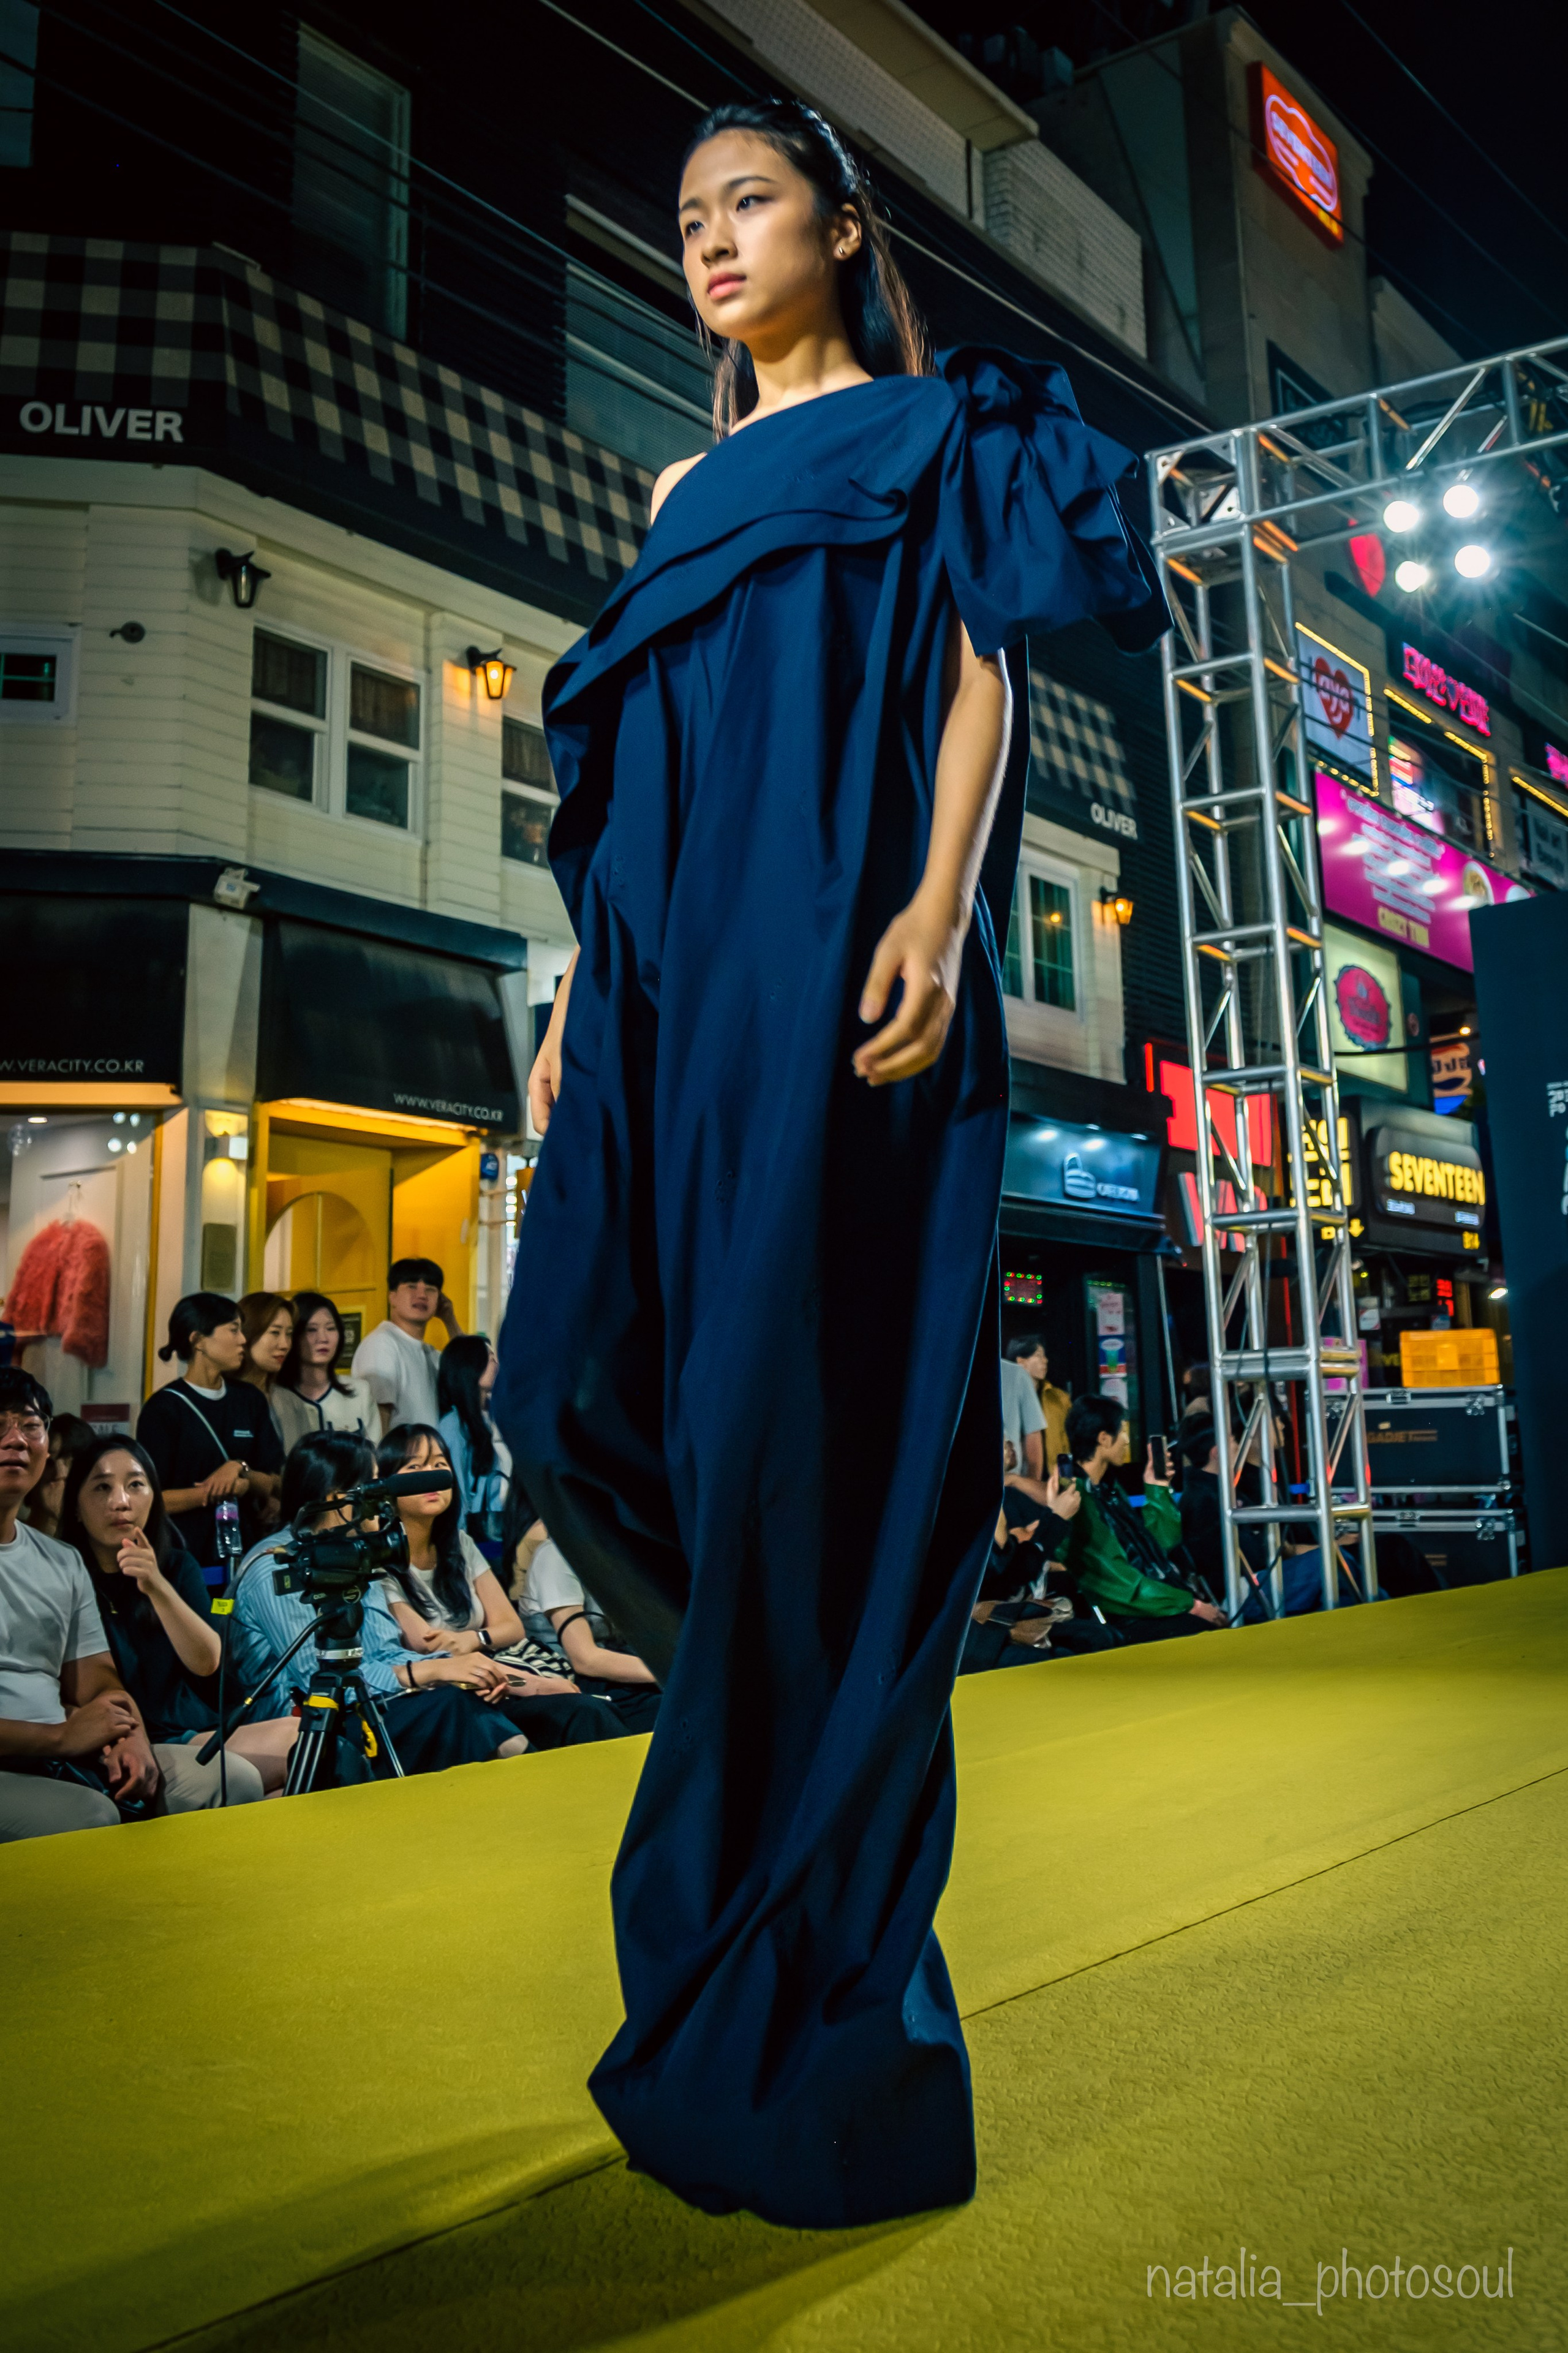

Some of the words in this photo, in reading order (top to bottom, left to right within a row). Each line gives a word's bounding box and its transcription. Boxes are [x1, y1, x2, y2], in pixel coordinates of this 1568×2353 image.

[19, 401, 184, 443] OLIVER
[1091, 802, 1138, 840] OLIVER
[393, 1093, 503, 1122] WWW.VERACITY.CO.KR
[1388, 1150, 1485, 1206] SEVENTEEN
